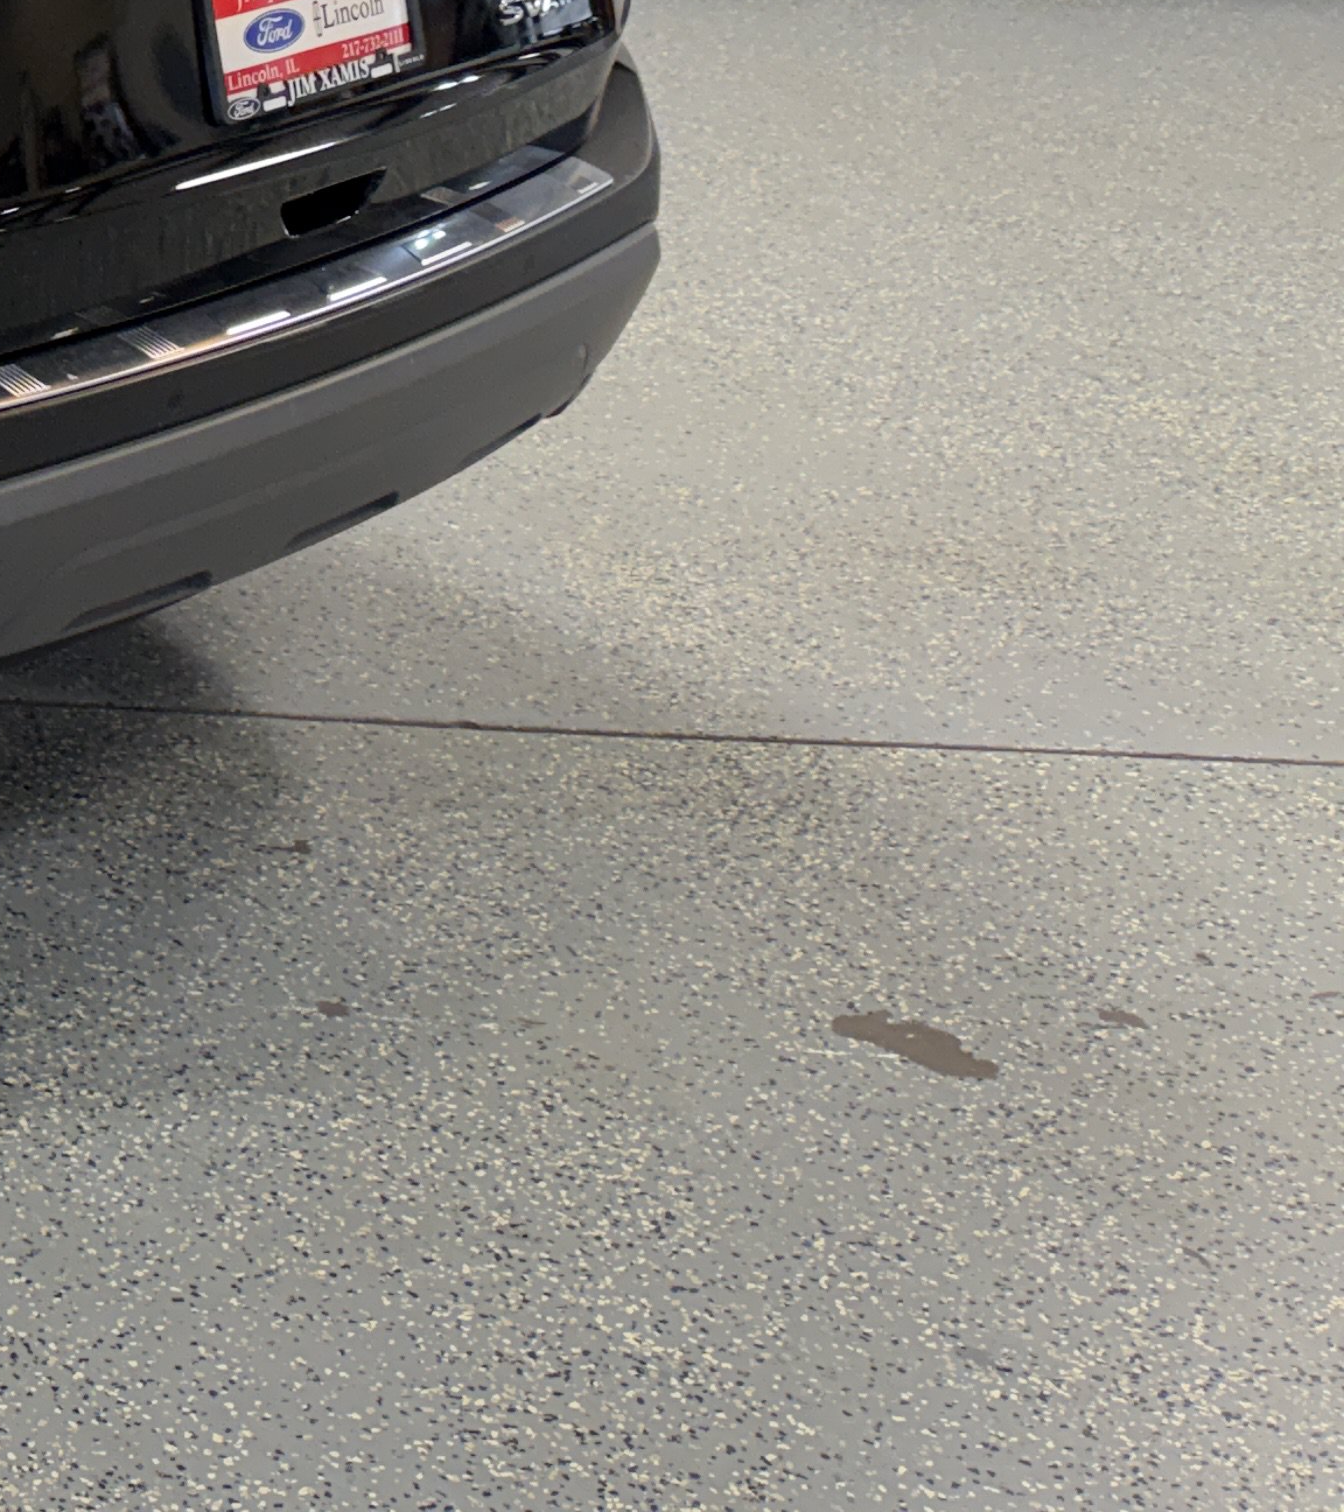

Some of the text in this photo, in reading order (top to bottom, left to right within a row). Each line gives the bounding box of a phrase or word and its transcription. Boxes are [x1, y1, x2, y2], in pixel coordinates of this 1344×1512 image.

[227, 58, 300, 91] Lincoln, IL
[288, 78, 317, 107] JIM
[319, 59, 372, 88] XAMIS
